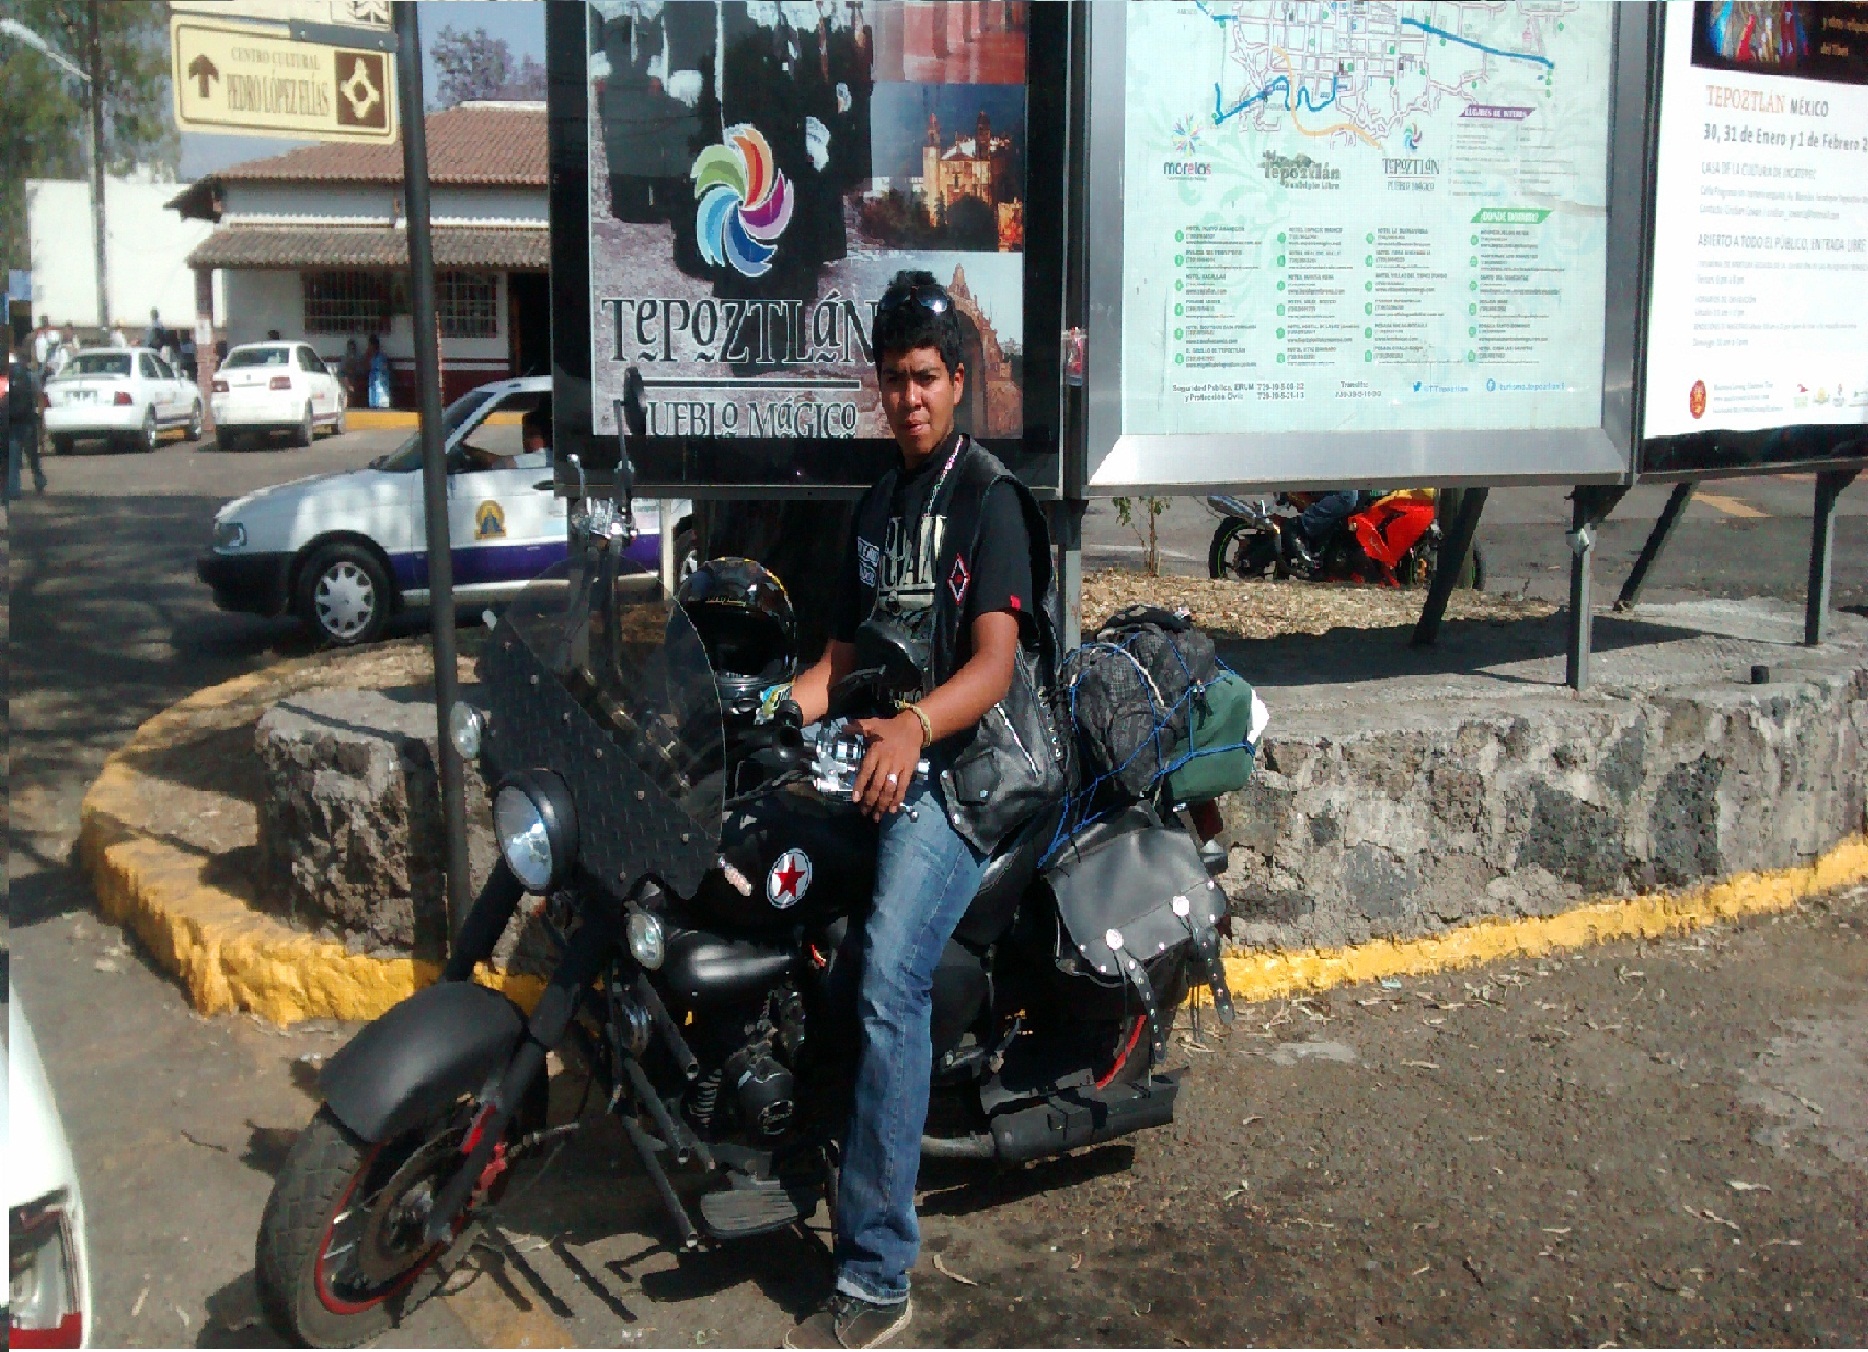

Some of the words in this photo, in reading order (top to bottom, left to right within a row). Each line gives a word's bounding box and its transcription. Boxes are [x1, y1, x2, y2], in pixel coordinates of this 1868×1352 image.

[231, 47, 269, 63] CENTRO
[273, 52, 320, 70] CULTURAL
[227, 74, 262, 112] PEDRO
[263, 69, 297, 114] LÓPEZ
[1706, 85, 1785, 113] TEPOZTLÁN
[1790, 95, 1829, 117] MÉXICO
[1704, 123, 1720, 143] 30,
[1724, 124, 1736, 141] 31
[1740, 125, 1752, 142] de
[1756, 128, 1786, 146] Enero
[1790, 133, 1796, 150] y
[1797, 131, 1804, 146] 1
[1807, 130, 1818, 147] de
[1822, 134, 1860, 151] Febrero
[1163, 161, 1211, 175] morelos
